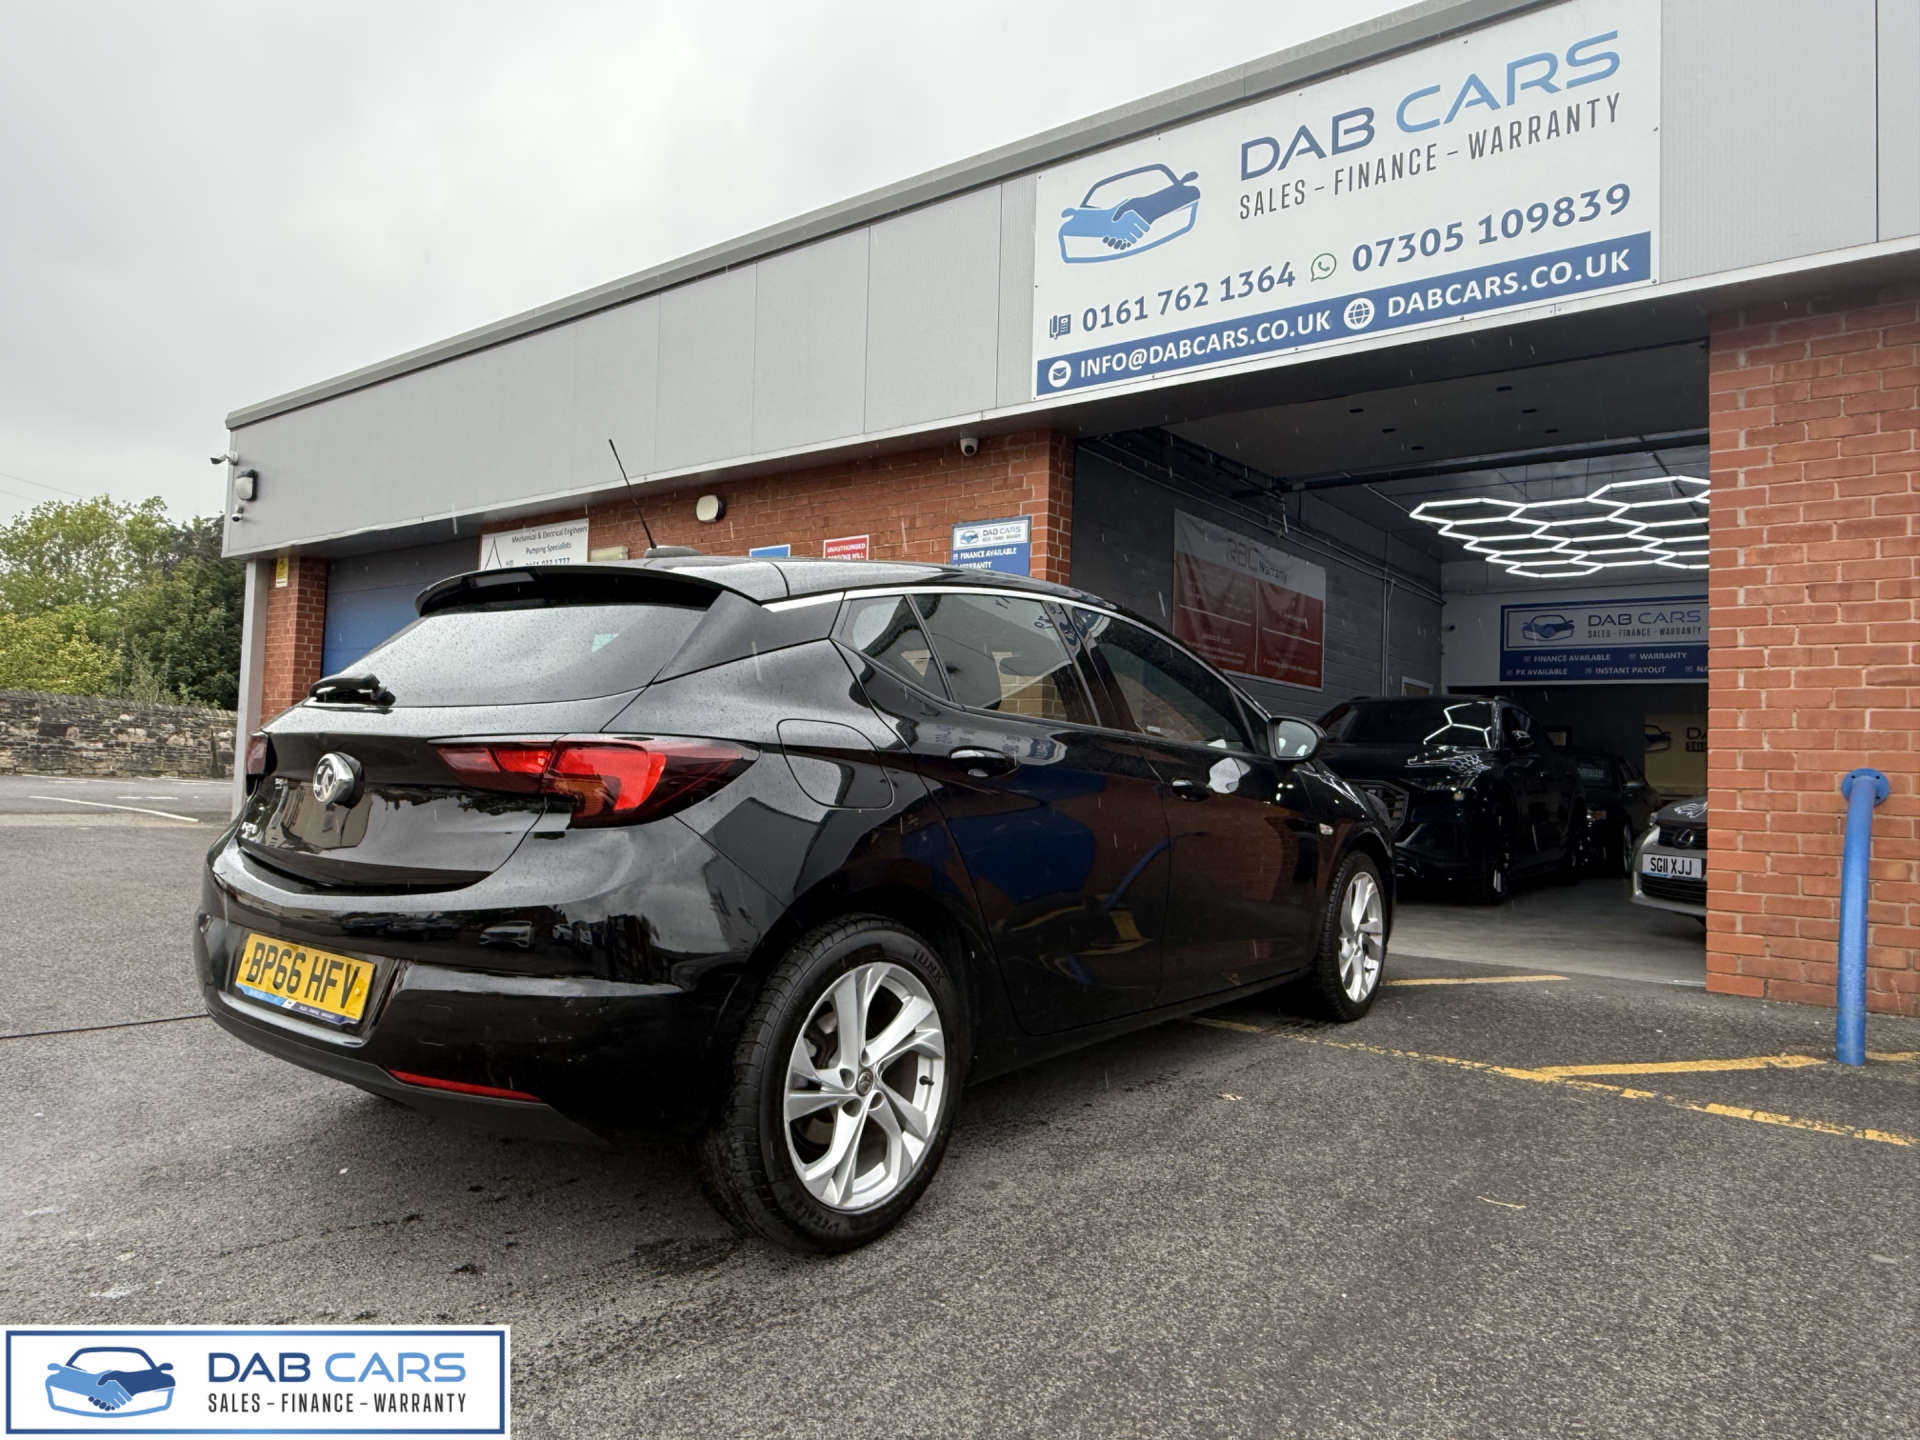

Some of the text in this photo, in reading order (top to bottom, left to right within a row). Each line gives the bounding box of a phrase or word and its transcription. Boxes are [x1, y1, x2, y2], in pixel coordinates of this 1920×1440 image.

[1241, 30, 1620, 181] DAB CARS
[1239, 179, 1305, 220] SALES
[1335, 143, 1437, 195] FINANCE
[1468, 92, 1620, 160] WARRANTY
[1352, 183, 1631, 272] 07305 109839
[1082, 261, 1296, 332] 0161 762 1364
[1387, 248, 1630, 317] DABCARS.CO.UK
[1080, 310, 1330, 378] INFO@DABCARS.CO.UK
[960, 547, 1017, 560] FINANCE AVAILABLE
[1588, 610, 1702, 627] DAB CARS
[1588, 626, 1702, 638] SALES FINANCE WARRANTY
[1533, 653, 1610, 662] FINANCE AVAILABLE
[1640, 652, 1687, 660] WARRANTY
[1650, 857, 1692, 875] SG11 XJJ
[246, 942, 361, 1009] BP66 HFV
